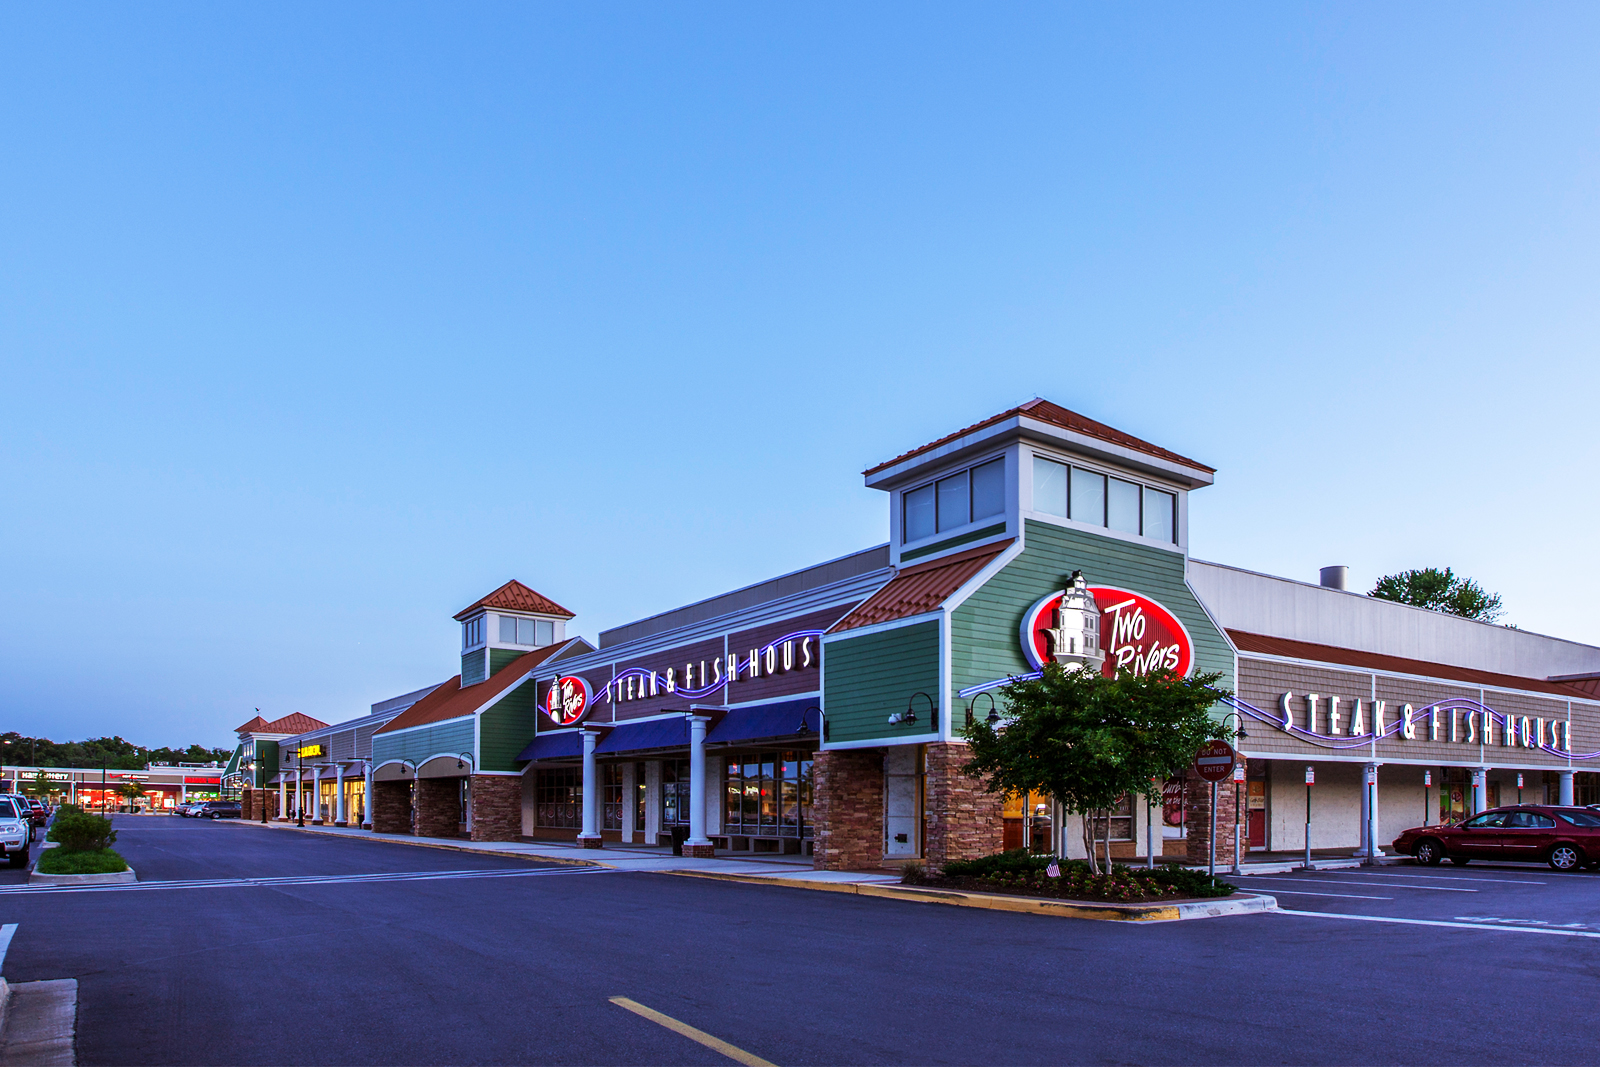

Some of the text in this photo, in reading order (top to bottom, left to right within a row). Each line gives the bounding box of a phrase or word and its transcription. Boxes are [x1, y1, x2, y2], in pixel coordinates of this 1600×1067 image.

[1104, 598, 1146, 655] Two
[606, 671, 659, 704] STEAK
[666, 667, 676, 693] &
[685, 653, 737, 690] FISH
[1114, 640, 1180, 681] Rivers
[1280, 691, 1571, 750] STEAK & FISH HOUSE
[1203, 765, 1225, 773] ENTER
